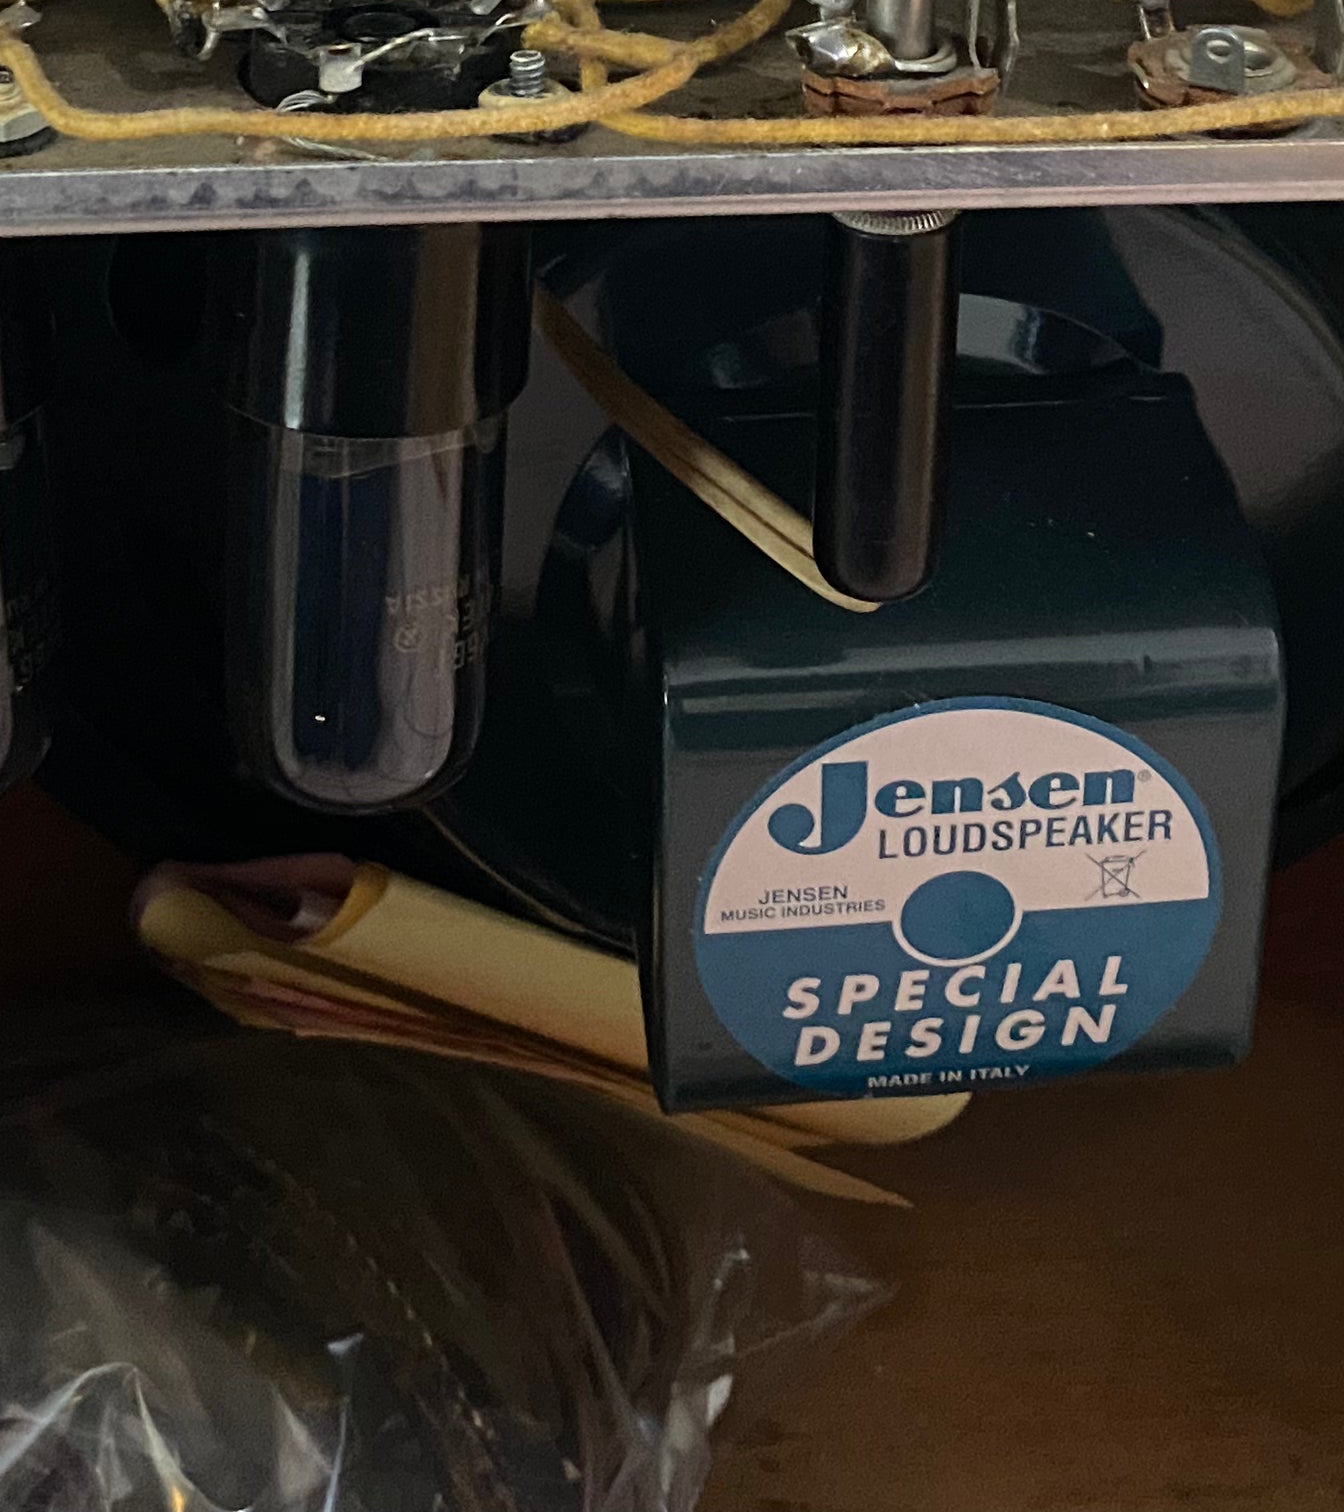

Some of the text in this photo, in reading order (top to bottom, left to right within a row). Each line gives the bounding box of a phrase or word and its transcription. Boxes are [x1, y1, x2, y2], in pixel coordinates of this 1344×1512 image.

[767, 760, 1135, 855] Jensen
[877, 808, 1172, 860] LOUDSPEAKER
[720, 898, 886, 923] MUSIC INDUSTRIES
[758, 885, 848, 905] JENSEN
[782, 955, 1129, 1019] SPECIAL
[793, 1004, 1116, 1066] DESIGN
[867, 1063, 1030, 1088] MADE IN ITALY
